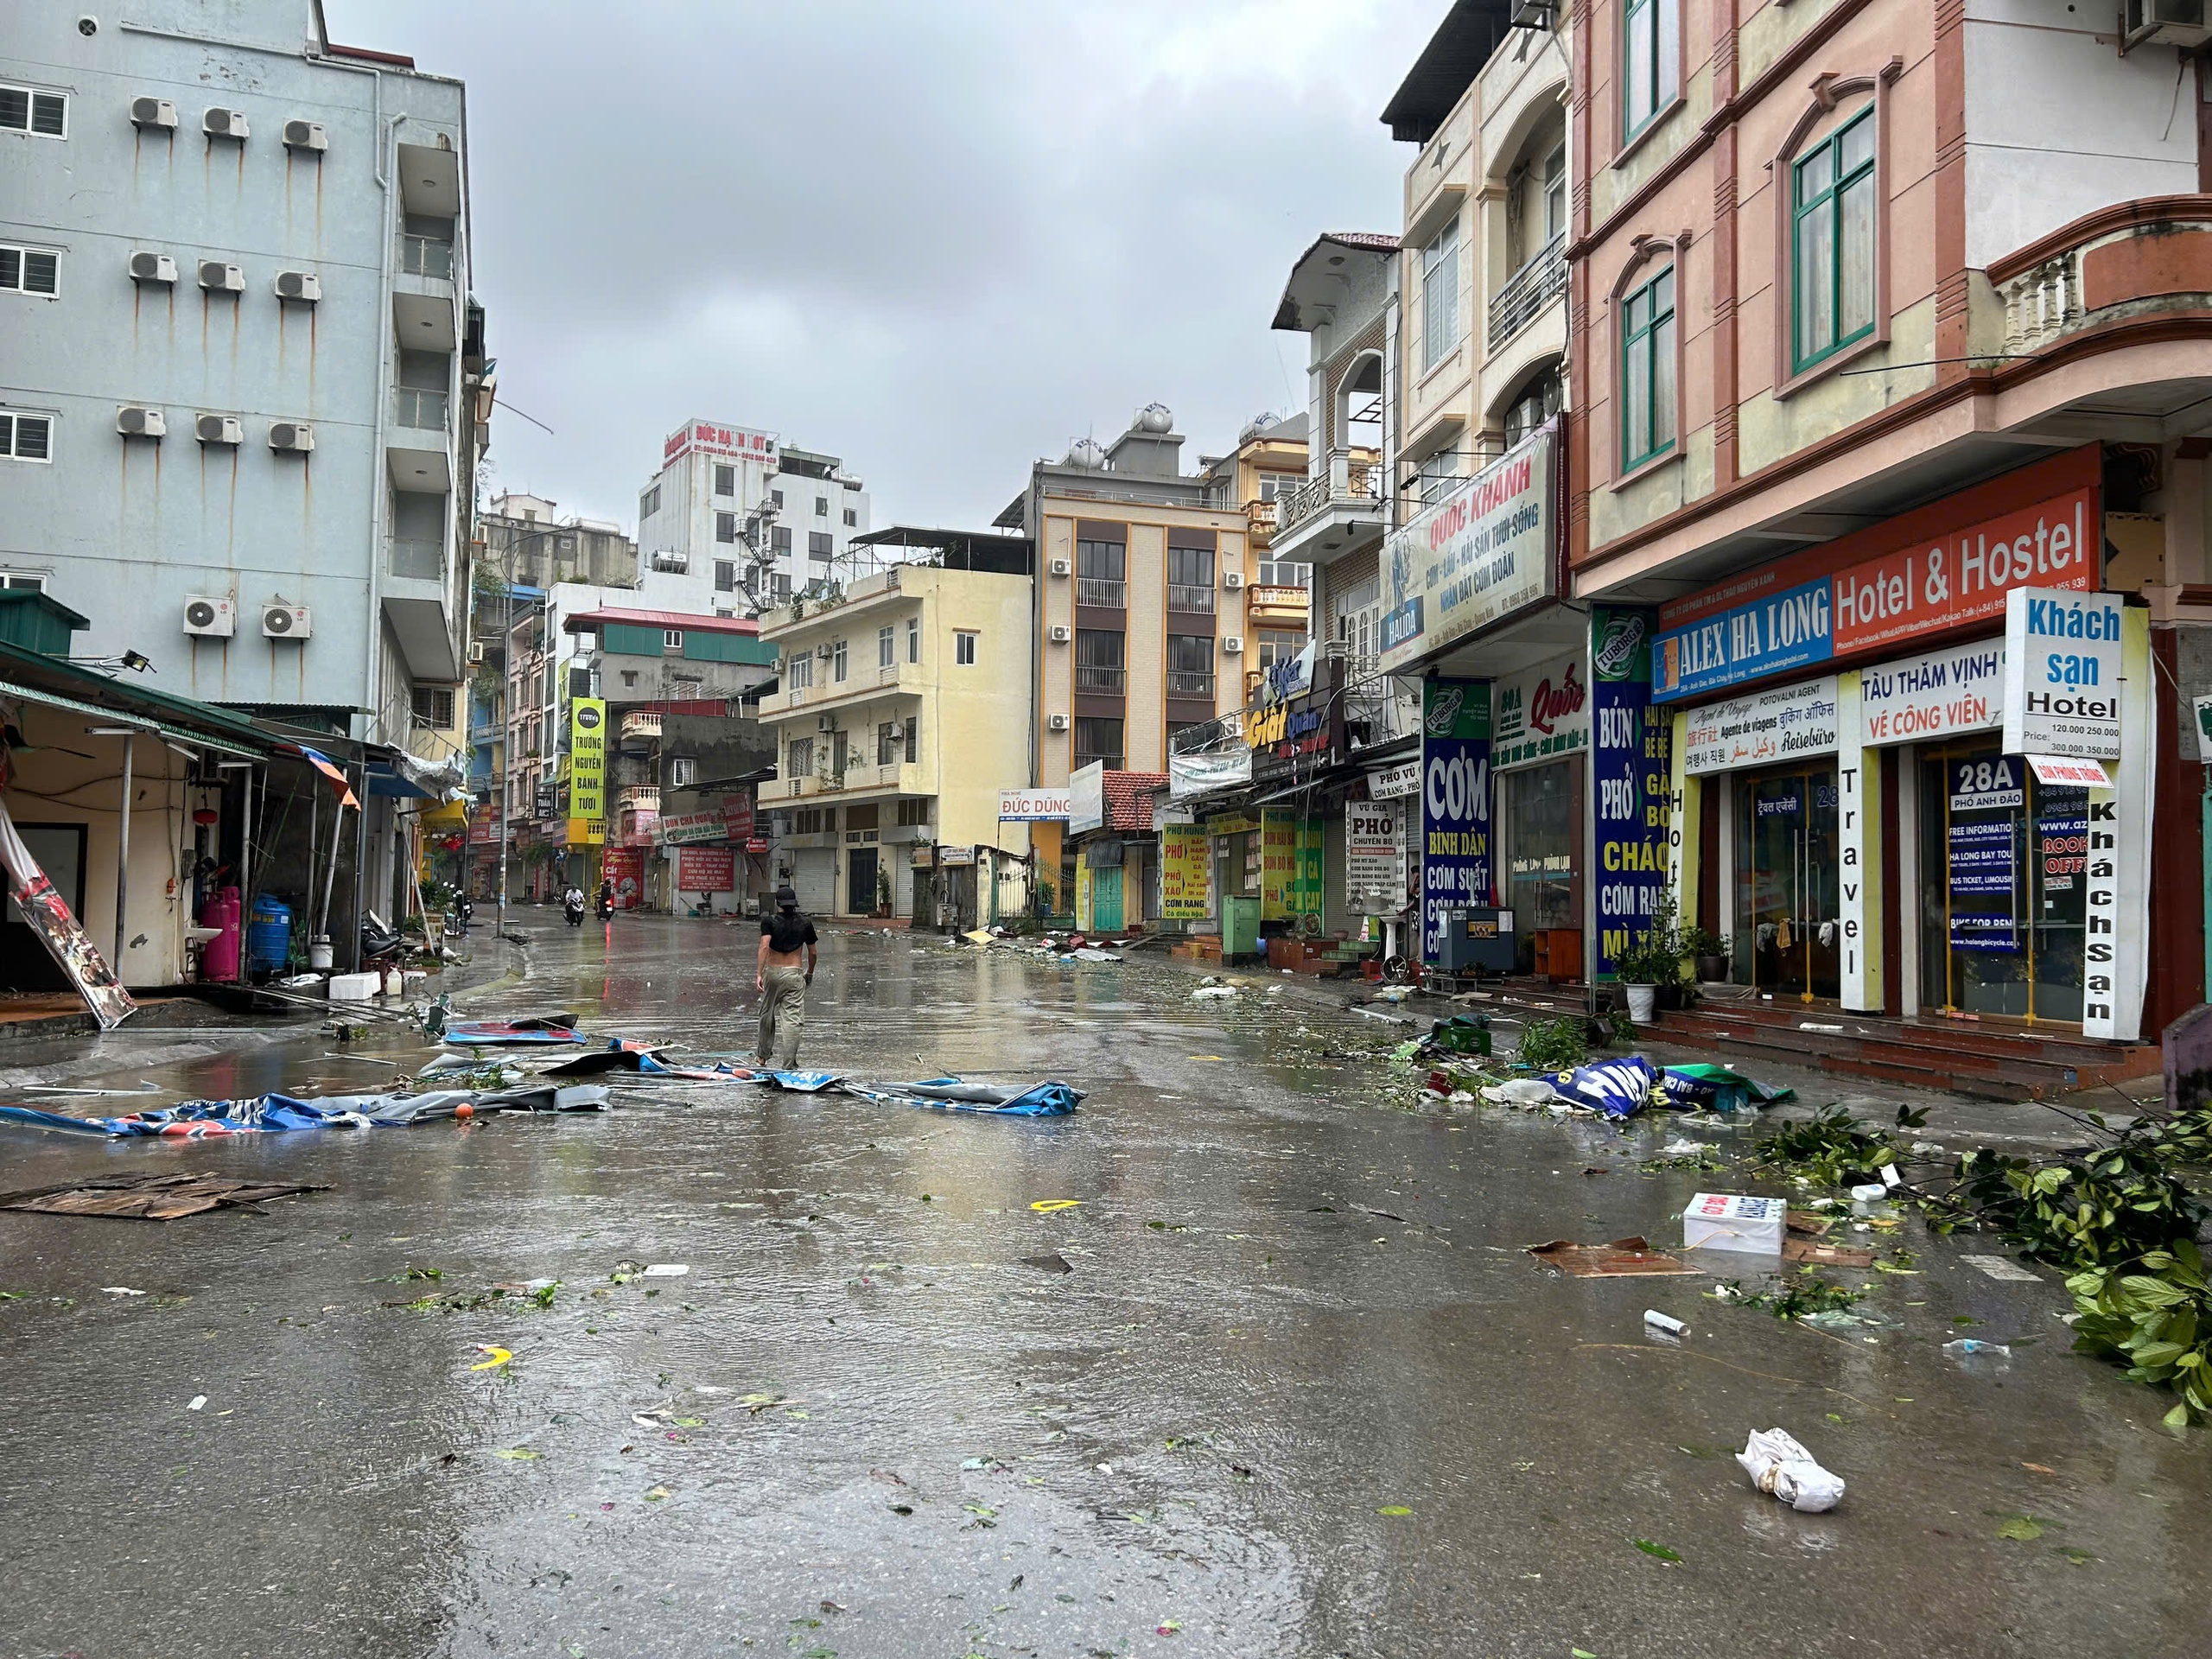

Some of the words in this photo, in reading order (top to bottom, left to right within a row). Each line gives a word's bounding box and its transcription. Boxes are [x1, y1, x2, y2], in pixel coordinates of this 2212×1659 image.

[1430, 494, 1467, 552] QUỐC
[1471, 454, 1532, 524] KHÁNH
[1512, 499, 1539, 537] SỐNG
[1473, 562, 1491, 594] CƠM
[1492, 550, 1515, 585] ĐOÀN
[1837, 556, 1912, 630] Hotel
[1925, 547, 1948, 605] &
[1961, 500, 2082, 595] Hostel
[2071, 577, 2087, 589] 939
[1389, 609, 1417, 645] HALIDA
[2028, 598, 2120, 641] Khách
[1680, 621, 1726, 677] ALEX
[1732, 611, 1761, 662] HA
[1767, 587, 1828, 652] LONG
[1598, 629, 1637, 668] TUBORG
[1861, 672, 1892, 702] TÀU
[1897, 661, 1946, 695] THĂM
[1952, 651, 1997, 689] VỊNH
[2047, 653, 2099, 692] sạn
[1759, 690, 1796, 707] POTOVALNI
[1797, 684, 1821, 699] AGENT
[2027, 691, 2116, 718] Hotel
[1427, 698, 1458, 728] TUBORG
[1599, 696, 1634, 749] BÚN
[1869, 709, 1888, 739] VÉ
[1893, 704, 1940, 735] CÔNG
[1947, 693, 1986, 727] VIÊN
[1248, 699, 1289, 753] Giật
[1287, 705, 1319, 740] Quán
[1687, 725, 1718, 747] 旅行社
[1721, 725, 1742, 740] Agente
[1743, 720, 1751, 734] de
[1751, 715, 1777, 734] viagens
[2024, 731, 2050, 741] Price:
[2051, 724, 2084, 734] 120.000
[2087, 726, 2119, 737] 250.000
[575, 734, 601, 749] TRƯỜNG
[1781, 728, 1836, 752] Reisebüro
[2051, 743, 2083, 753] 300.000
[2087, 745, 2119, 755] 350.000
[575, 753, 601, 770] NGUYỄN
[1686, 751, 1708, 768] 여행사
[1710, 748, 1726, 764] 직원
[577, 775, 598, 790] BÁNH
[1379, 768, 1400, 785] PHỞ
[1402, 766, 1415, 779] VŨ
[1427, 746, 1488, 821] CƠM
[1646, 769, 1670, 796] GÀ
[1959, 760, 2014, 793] 28A
[1387, 785, 1403, 796] RANG
[1601, 762, 1633, 820] PHỞ
[1955, 794, 1974, 809] PHỐ
[1976, 795, 1997, 807] ANH
[1999, 792, 2021, 804] ĐÀO
[578, 797, 596, 810] TƯƠI
[1002, 797, 1030, 813] ĐỨC
[1034, 797, 1071, 813] DŨNG
[1647, 801, 1670, 827] BÒ
[1352, 813, 1394, 835] PHỞ
[1949, 827, 1965, 836] FREE
[1966, 823, 2018, 836] INFORMATIO
[2040, 819, 2088, 831] www.az
[1166, 840, 1184, 859] PHỞ
[1428, 826, 1458, 855] BÌNH
[1461, 827, 1486, 856] DÂN
[2043, 836, 2088, 854] BOOK
[1604, 835, 1669, 872] CHÁO
[1950, 853, 1960, 861] HA
[1961, 851, 1980, 861] LONG
[1981, 850, 1996, 860] BAY
[1997, 849, 2012, 859] TOU
[1165, 869, 1181, 880] PHỞ
[1308, 857, 1319, 880] CÁ
[1427, 864, 1455, 890] CƠM
[1841, 768, 1858, 974] Travel
[1165, 886, 1181, 896] XÀO
[1949, 876, 1961, 885] BUS
[1166, 899, 1182, 908] CƠM
[1185, 899, 1205, 908] RANG
[1306, 891, 1320, 911] CAY
[1601, 881, 1635, 915] CƠM
[1950, 938, 2020, 947] www.halongbicycle.co
